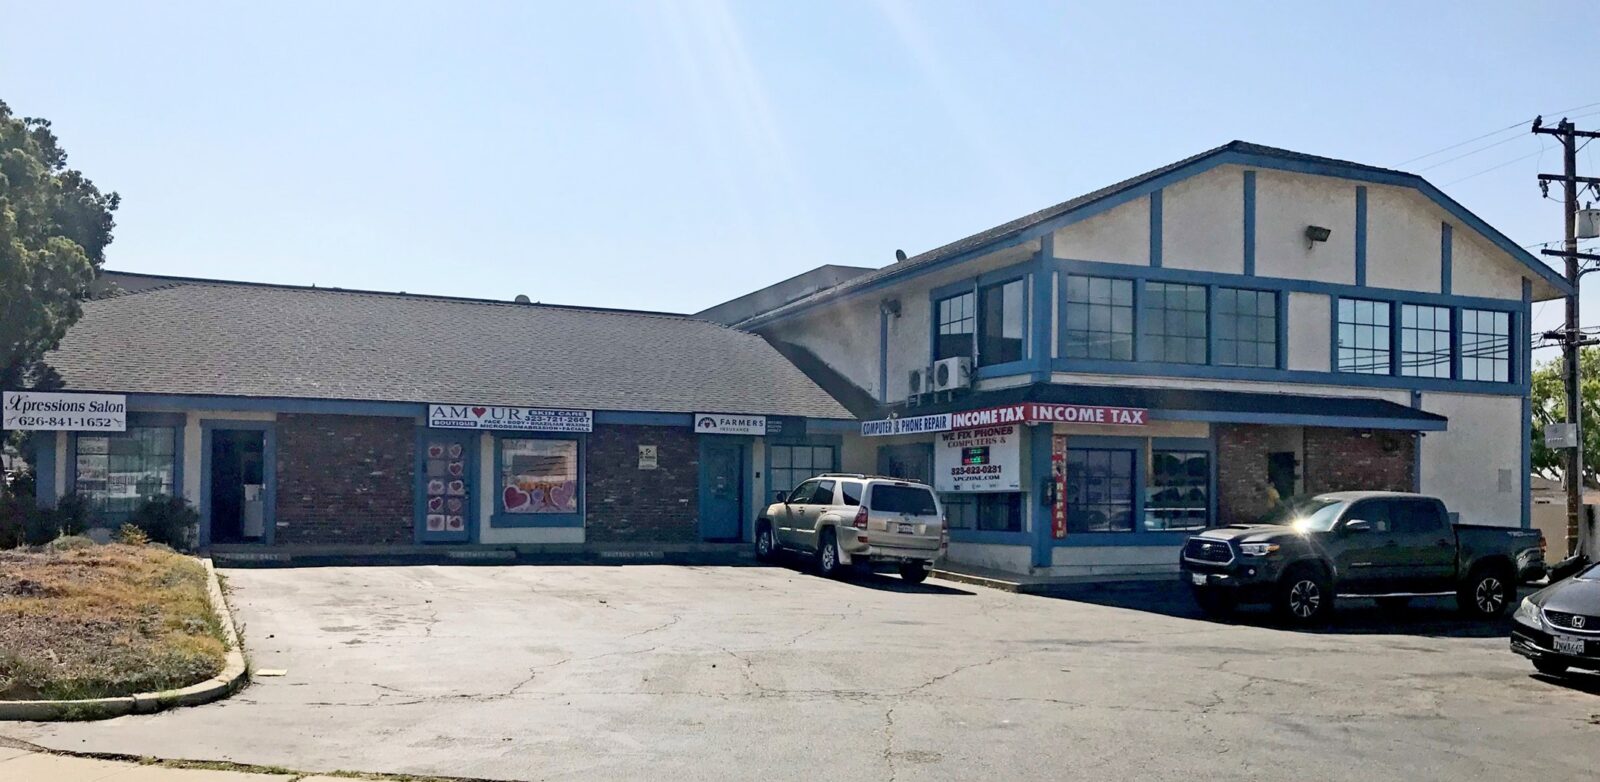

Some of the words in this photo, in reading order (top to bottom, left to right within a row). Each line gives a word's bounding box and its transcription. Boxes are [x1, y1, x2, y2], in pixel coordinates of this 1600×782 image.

[5, 395, 85, 413] Xpressions
[88, 401, 124, 412] Salon
[18, 417, 111, 427] 626-841-1652
[953, 409, 998, 428] INCOME
[999, 406, 1025, 421] TAX
[1032, 405, 1104, 422] INCOME
[1110, 409, 1144, 424] TAX
[720, 419, 764, 427] FARMERS
[863, 422, 893, 435] COMPUTER
[902, 419, 923, 433] PHONE
[924, 415, 947, 430] REPAIR
[942, 433, 955, 441] WE
[957, 430, 972, 439] FIX
[974, 426, 1014, 438] PHONES
[948, 438, 997, 448] COMPUTERS
